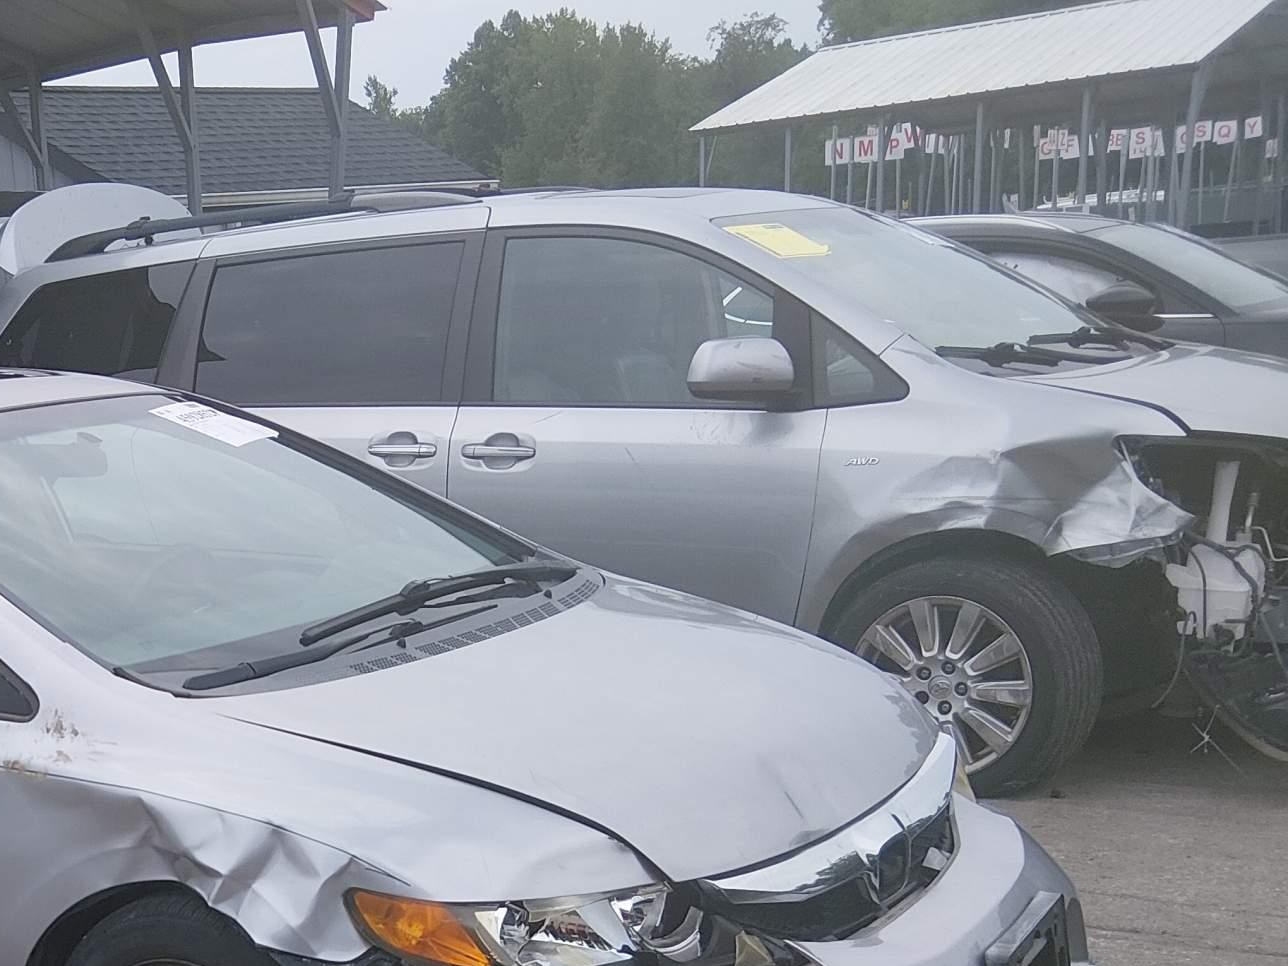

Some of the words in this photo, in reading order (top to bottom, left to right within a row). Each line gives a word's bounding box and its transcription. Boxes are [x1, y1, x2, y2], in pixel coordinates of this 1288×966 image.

[1196, 124, 1206, 138] S
[1218, 125, 1231, 138] Q
[1247, 121, 1257, 135] Y
[1135, 131, 1145, 144] S
[833, 142, 843, 159] N
[858, 139, 873, 157] M
[889, 138, 900, 155] P
[843, 456, 880, 467] AWD
